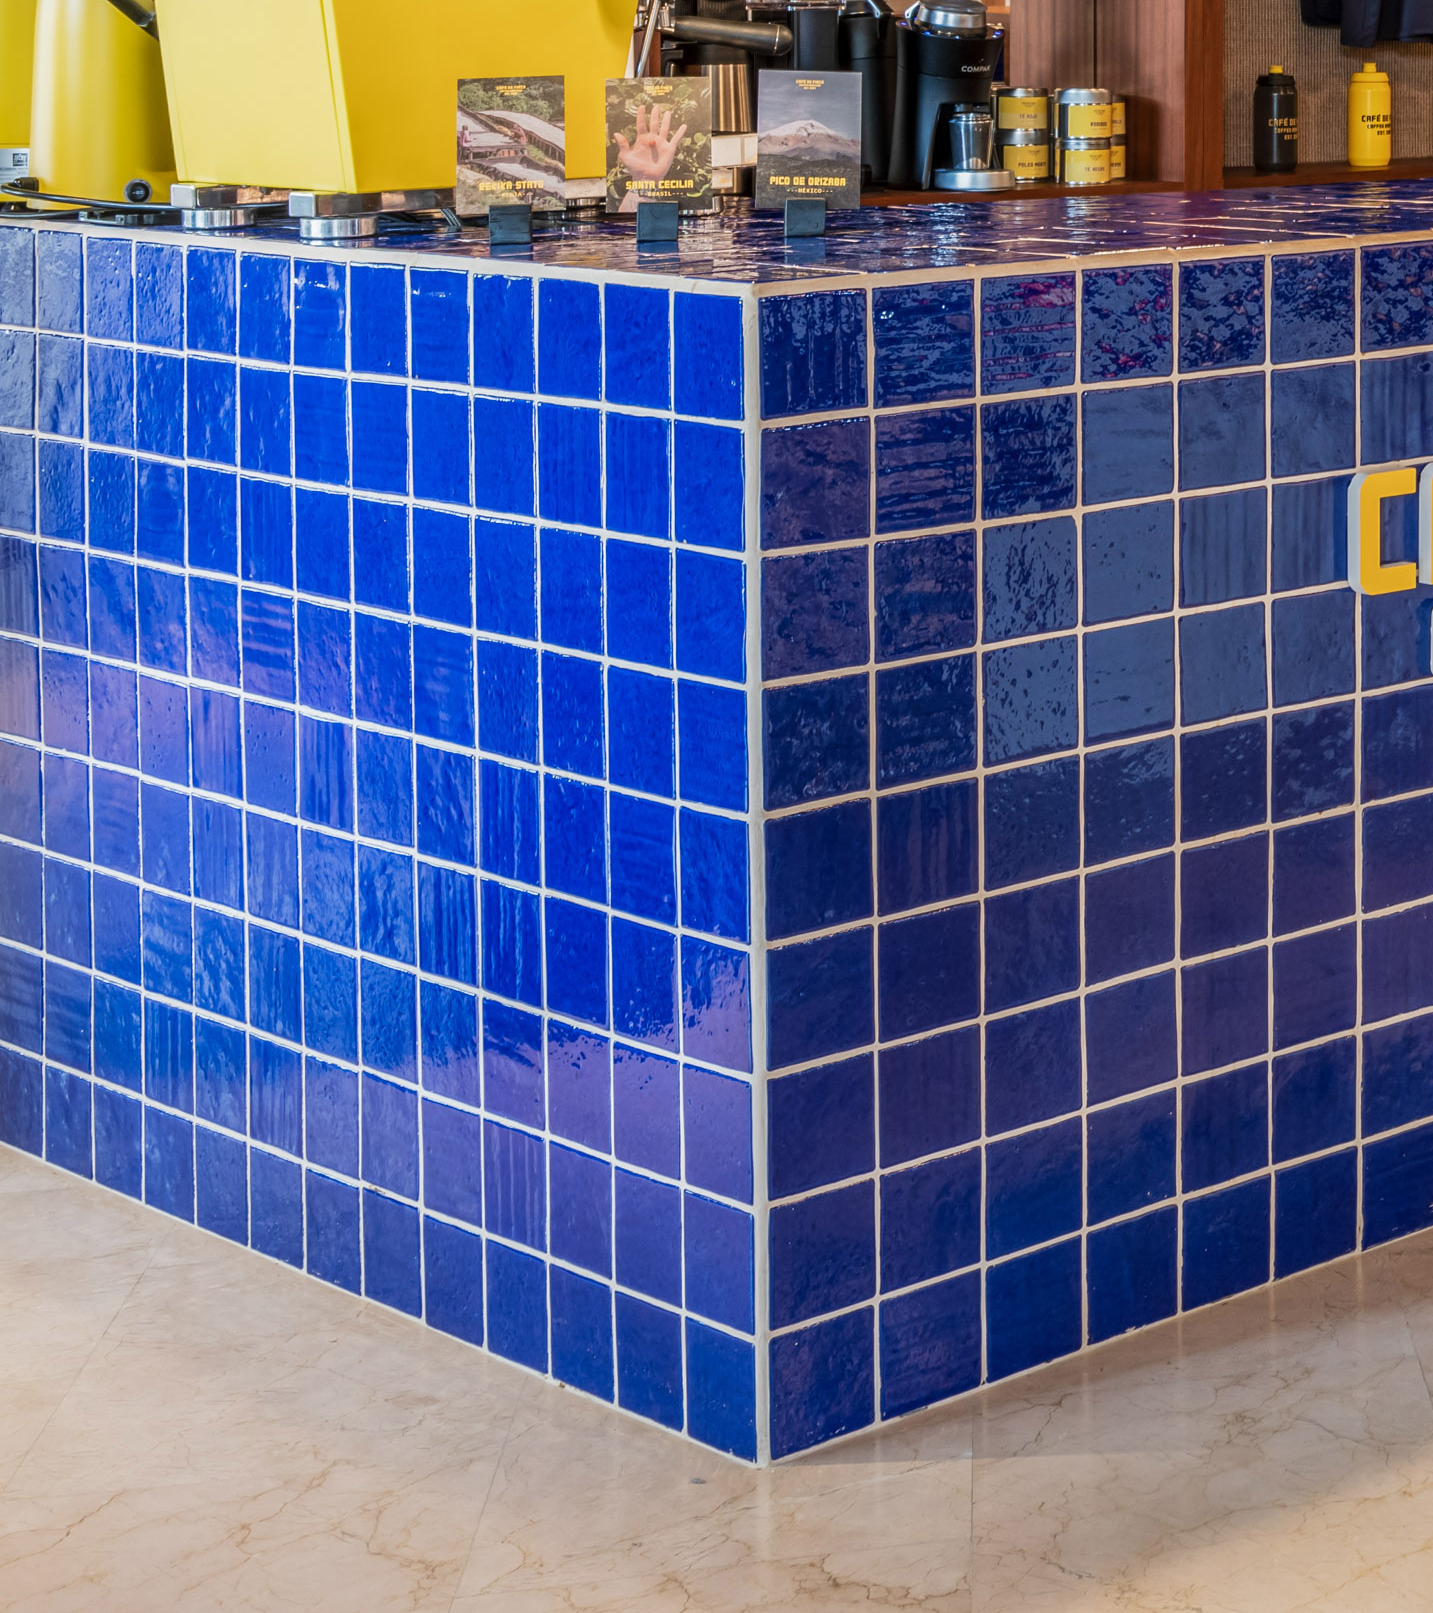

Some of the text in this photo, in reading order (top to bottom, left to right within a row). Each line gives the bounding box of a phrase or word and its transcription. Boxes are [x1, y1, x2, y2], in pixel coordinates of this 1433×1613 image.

[1268, 118, 1289, 127] CAFÉ
[1361, 114, 1381, 122] CAFÉ
[625, 180, 694, 190] SANTA CECILIA
[769, 176, 846, 187] PICO DE ORIZABA
